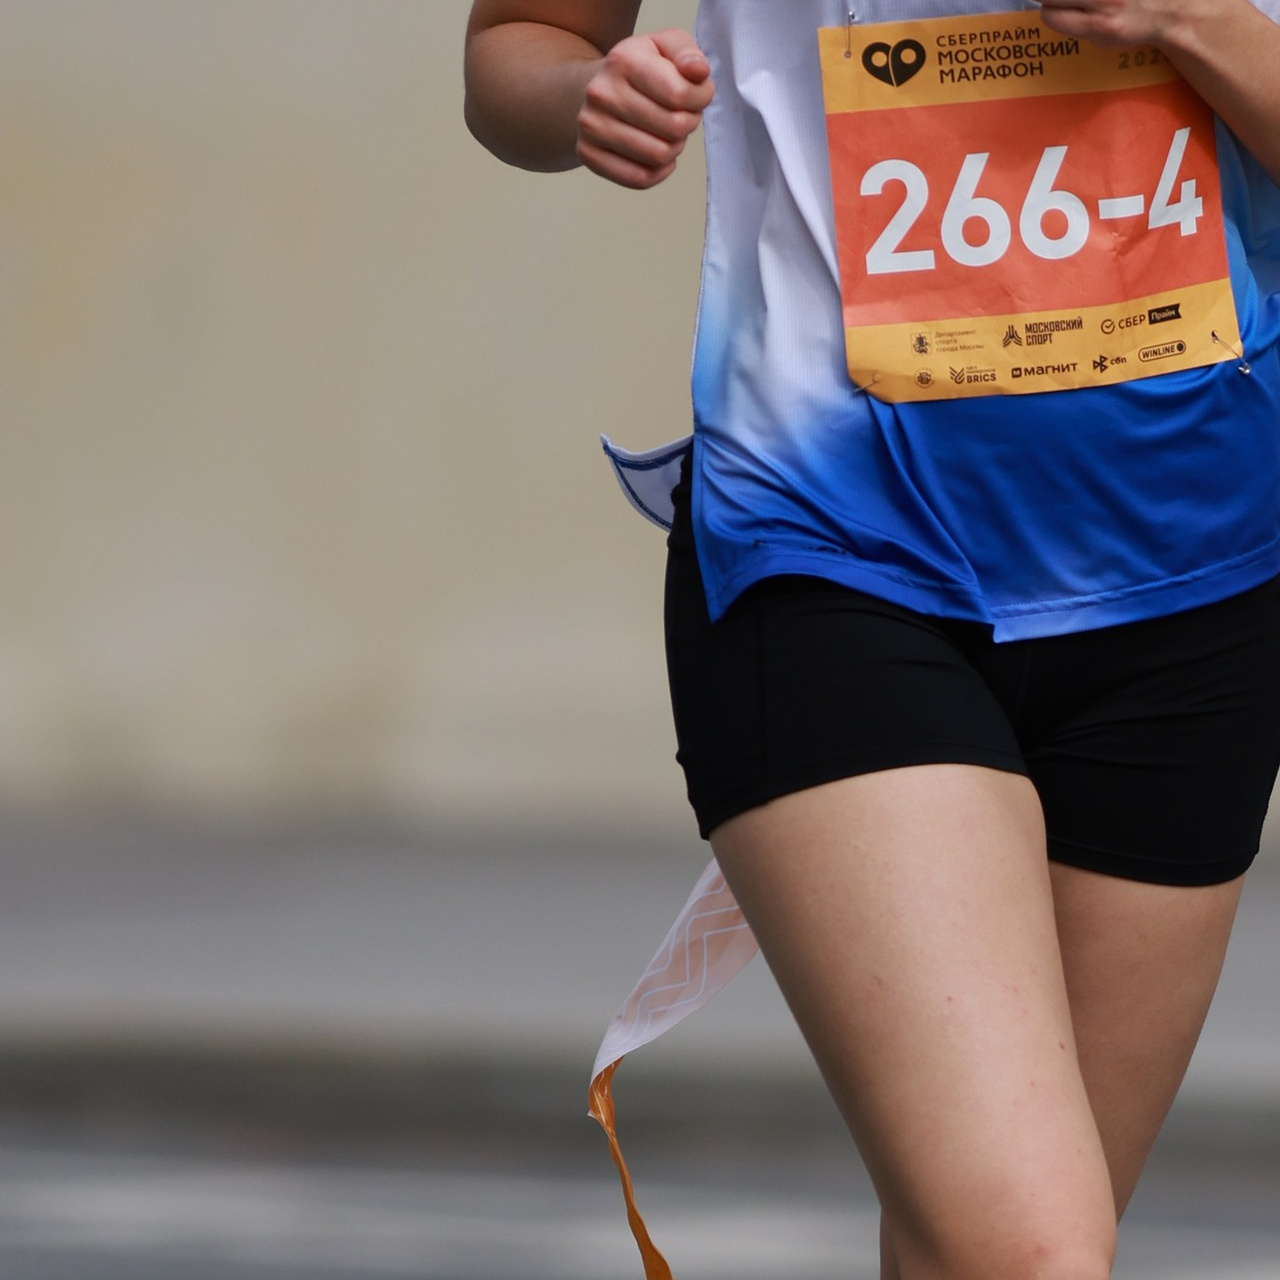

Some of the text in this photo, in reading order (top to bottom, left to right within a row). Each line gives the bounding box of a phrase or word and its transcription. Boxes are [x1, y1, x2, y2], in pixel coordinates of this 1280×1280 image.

[936, 26, 1041, 47] СБЕРПРАЙМ
[937, 37, 1080, 66] МОСКОВСКИЙ
[1118, 47, 1162, 70] 202
[939, 60, 1045, 84] МАРАФОН
[859, 126, 1204, 276] 266-4
[1025, 315, 1083, 334] МОСКОВСКИЙ
[1118, 313, 1147, 330] СБЕР
[1026, 333, 1053, 347] СПОРТ
[1141, 343, 1177, 360] WINLINE
[966, 372, 997, 384] BRICS
